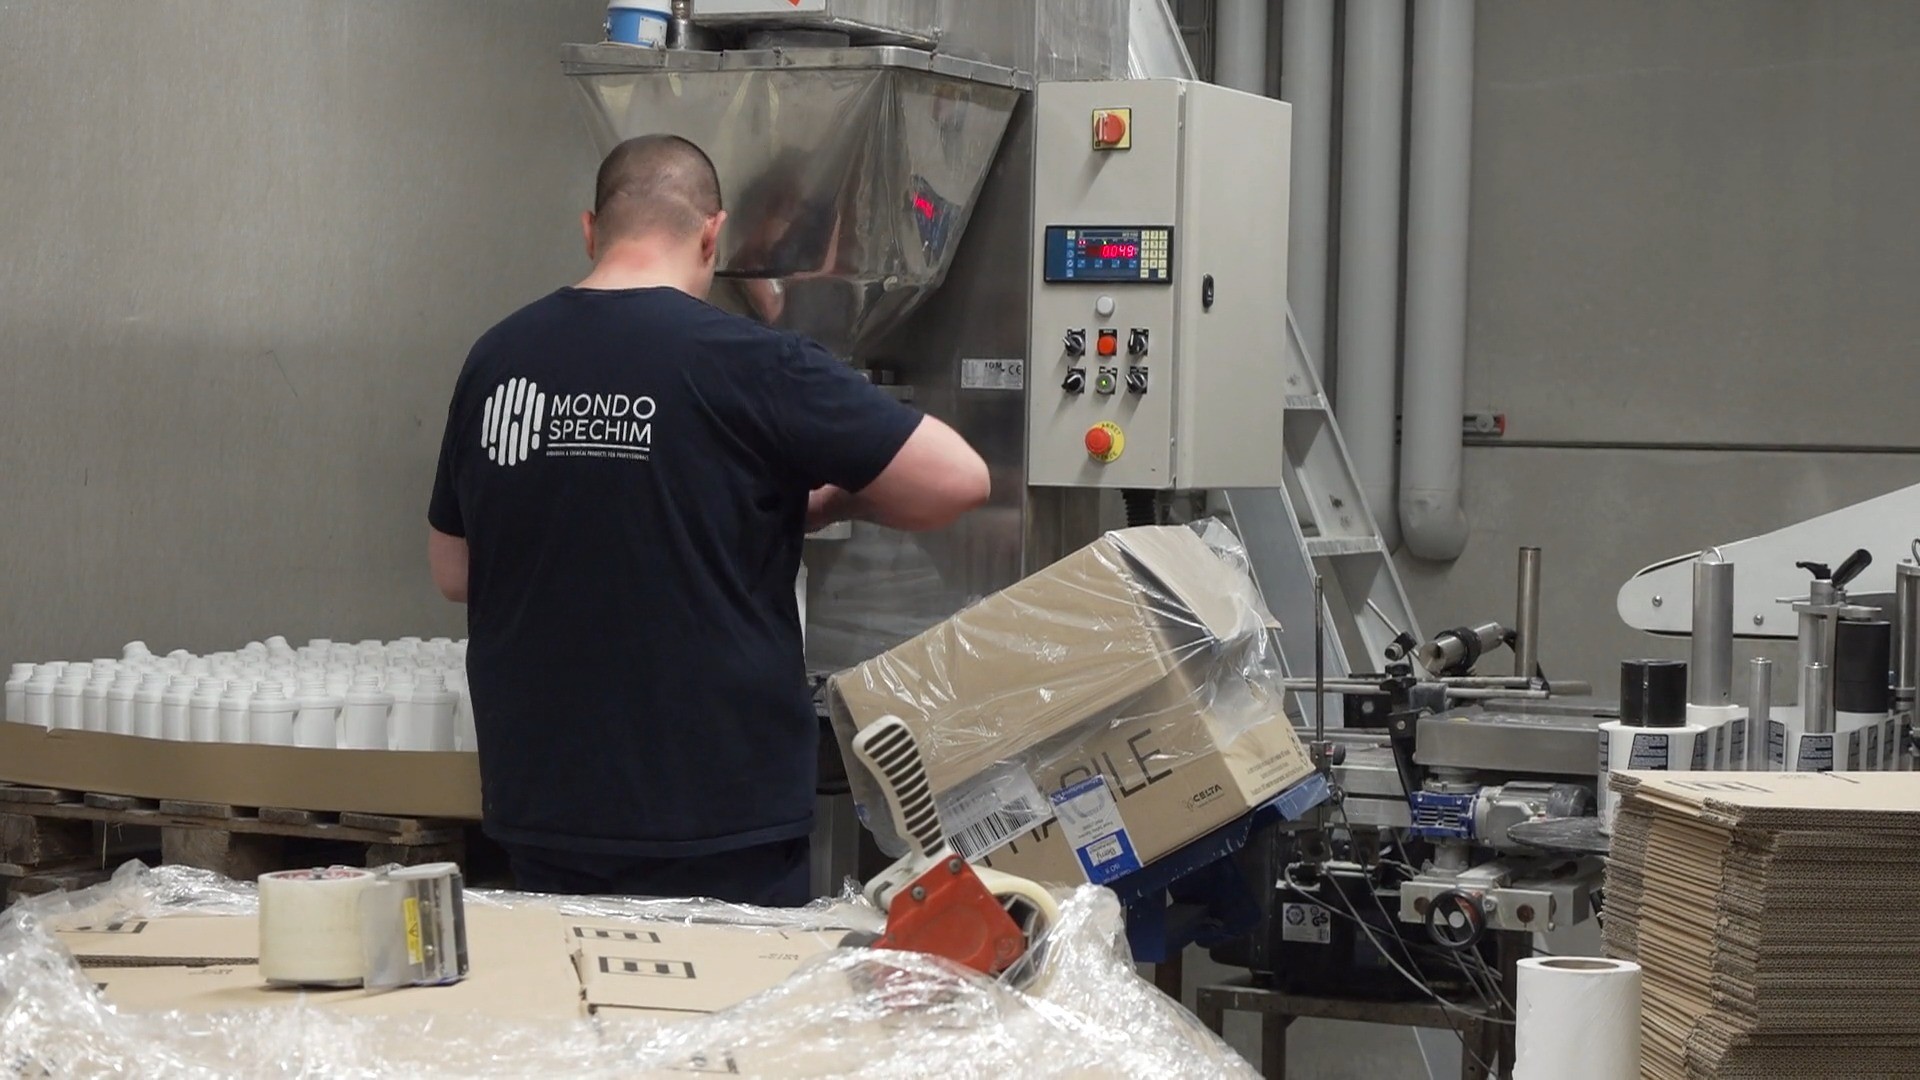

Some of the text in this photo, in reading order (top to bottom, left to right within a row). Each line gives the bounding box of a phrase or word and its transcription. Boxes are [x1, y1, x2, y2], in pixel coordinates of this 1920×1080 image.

[551, 394, 656, 419] MONDO
[548, 419, 651, 444] SPECHIM
[1192, 783, 1222, 802] CELTA
